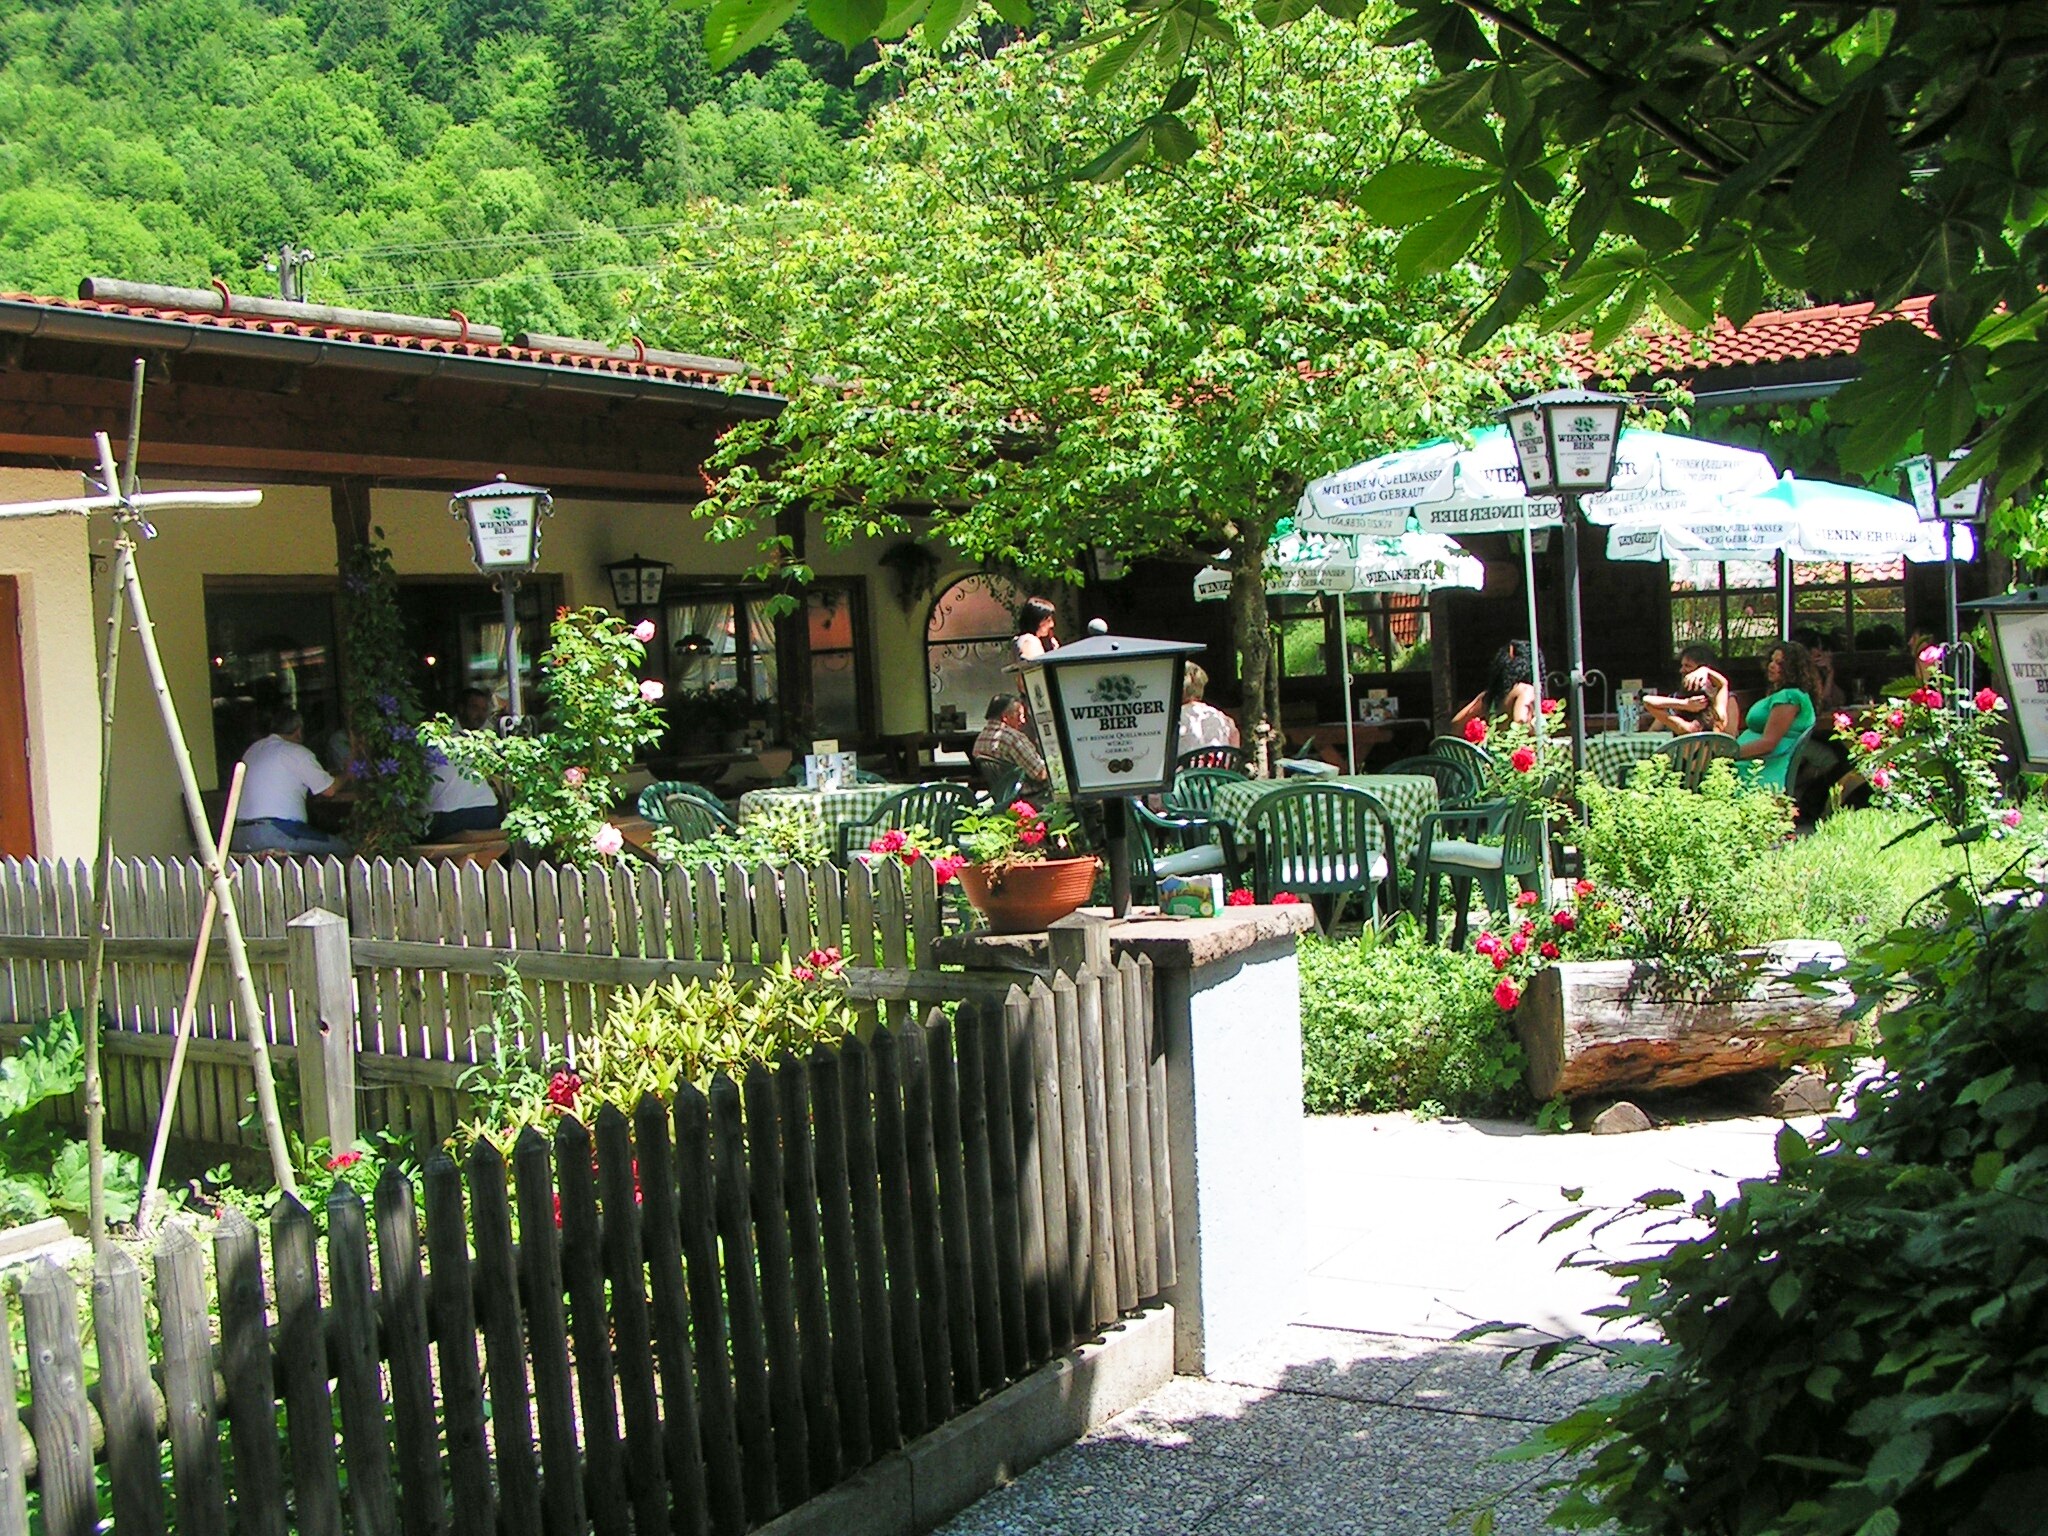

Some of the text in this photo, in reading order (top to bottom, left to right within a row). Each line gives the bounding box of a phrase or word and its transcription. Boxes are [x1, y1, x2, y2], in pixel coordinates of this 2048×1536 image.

[1558, 434, 1610, 443] WIENINGER
[1573, 442, 1595, 450] BIER
[1322, 485, 1340, 495] MIT
[1380, 487, 1425, 501] GEBRAUT
[479, 520, 528, 529] WIENINGER
[1070, 700, 1165, 720] WIENINGER
[1100, 716, 1138, 731] BIER
